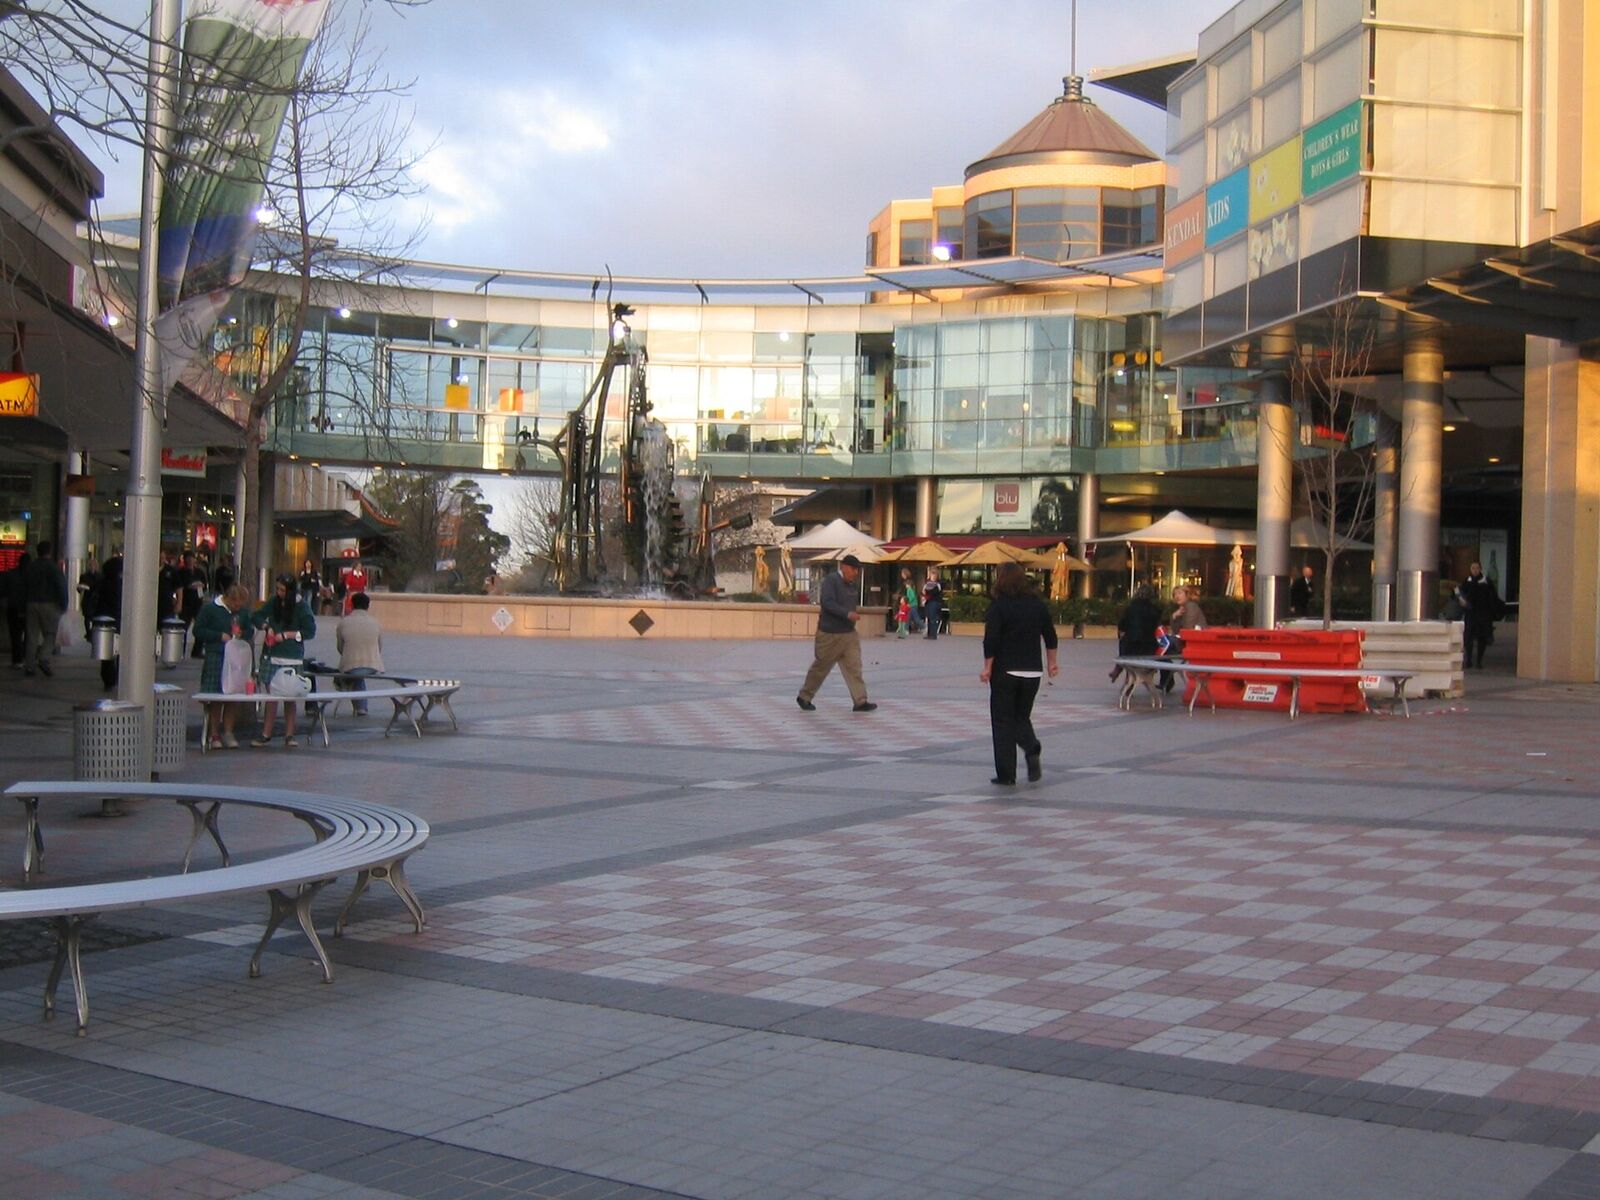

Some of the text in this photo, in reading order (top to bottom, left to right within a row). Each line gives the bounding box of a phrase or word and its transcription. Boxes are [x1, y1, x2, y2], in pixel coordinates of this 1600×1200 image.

[1340, 119, 1359, 140] WEAR
[1311, 159, 1326, 178] BOYS
[1331, 146, 1350, 169] GIRLS
[1167, 194, 1230, 251] KENDAL KIDS
[996, 492, 1018, 504] blu
